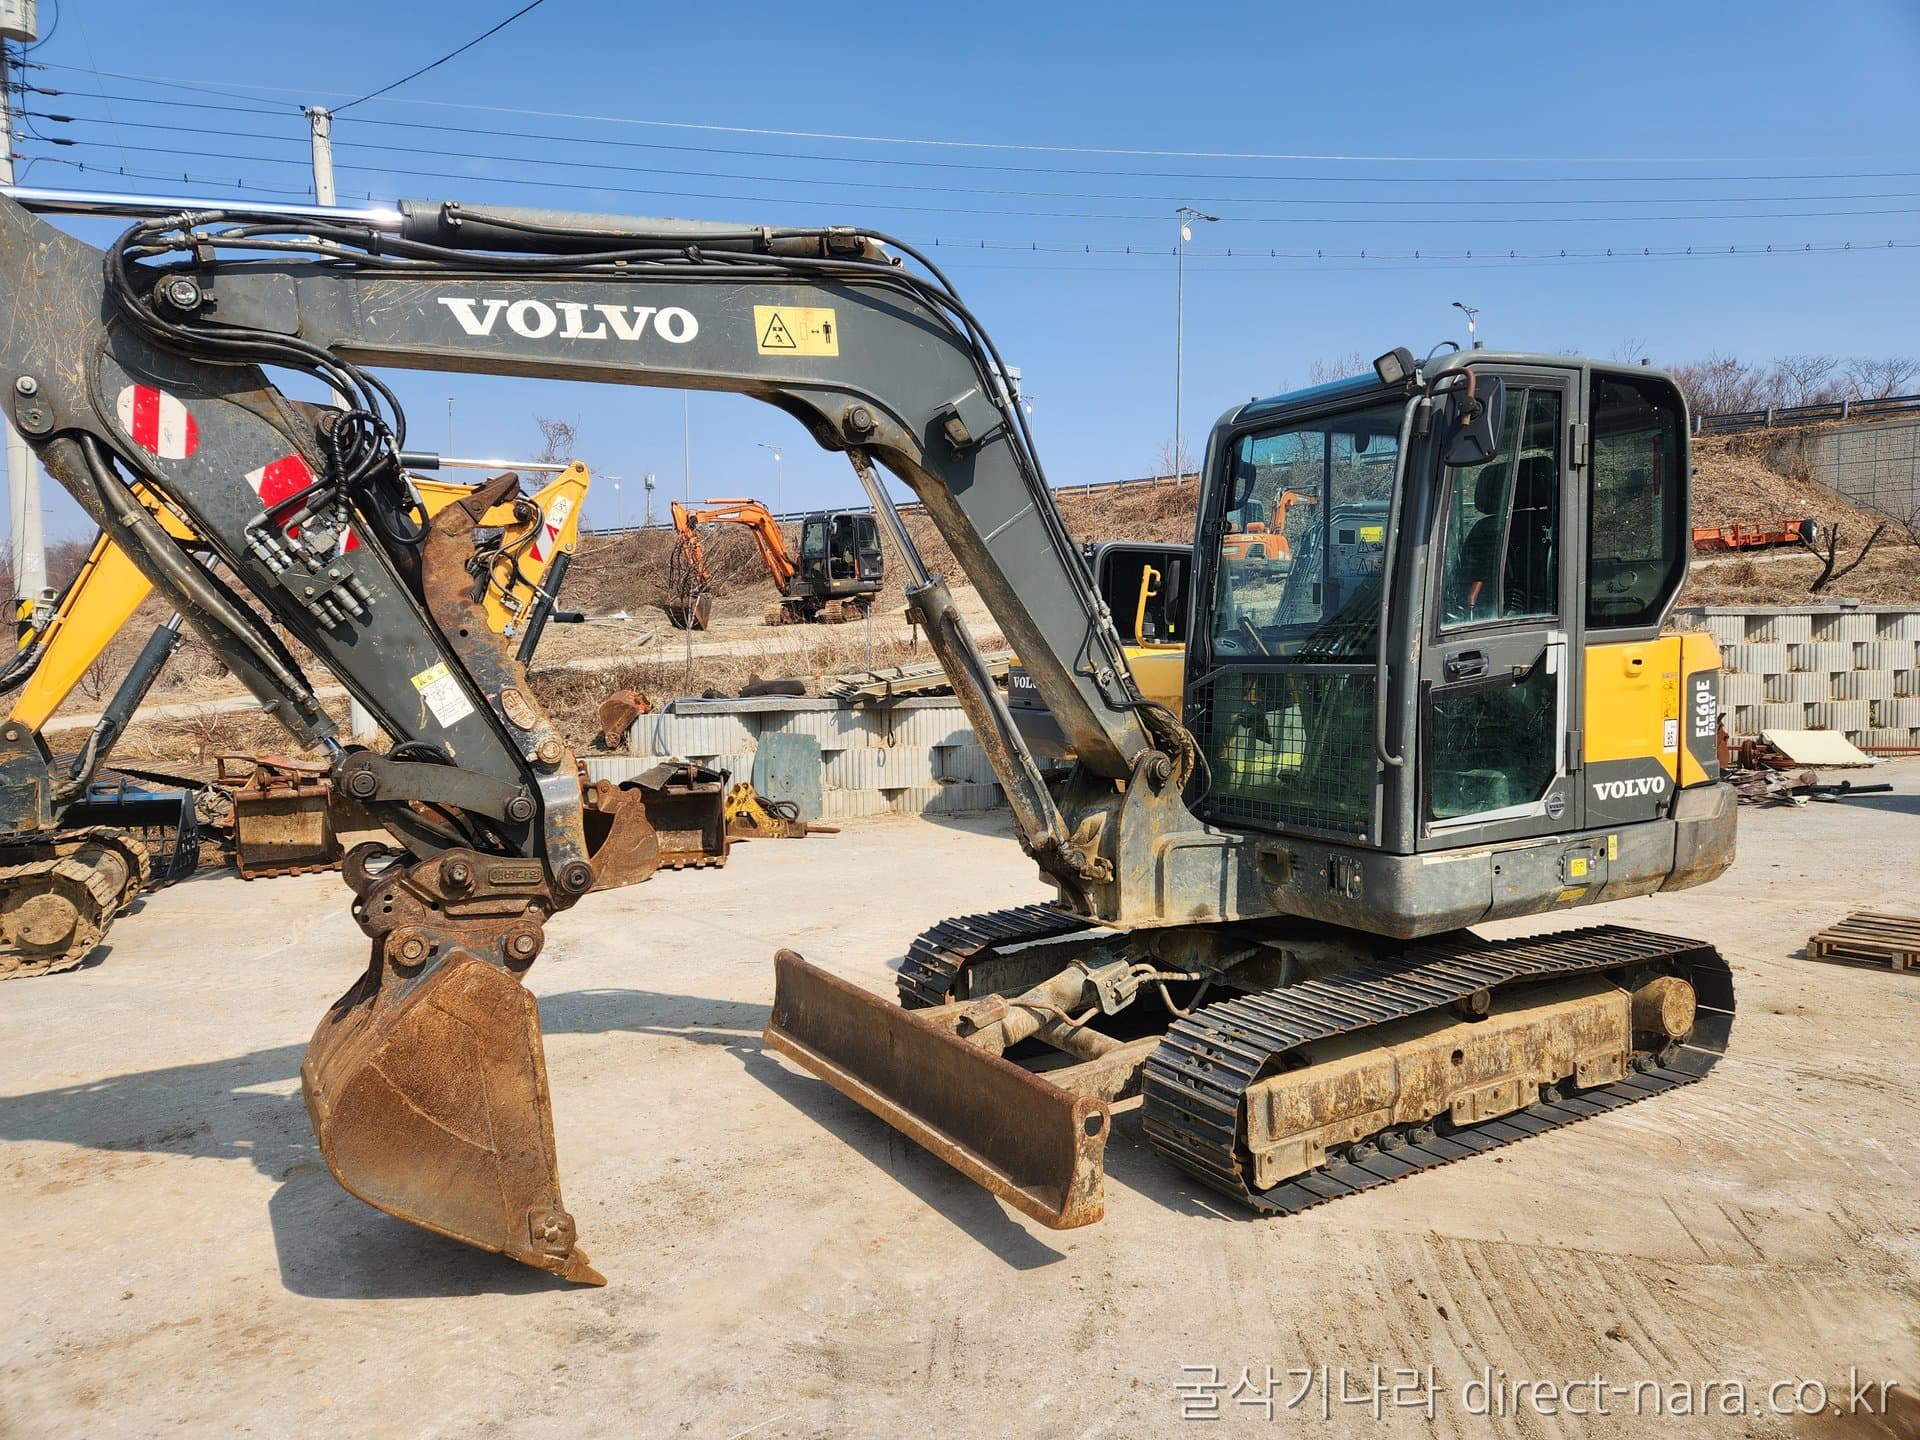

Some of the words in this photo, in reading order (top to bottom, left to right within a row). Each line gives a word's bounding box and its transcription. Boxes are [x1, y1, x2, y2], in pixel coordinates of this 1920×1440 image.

[437, 297, 699, 344] VOLVO
[1013, 676, 1037, 689] VOL
[1695, 679, 1710, 738] EC60E
[1708, 694, 1717, 736] FOREST
[1592, 776, 1666, 801] VOLVO
